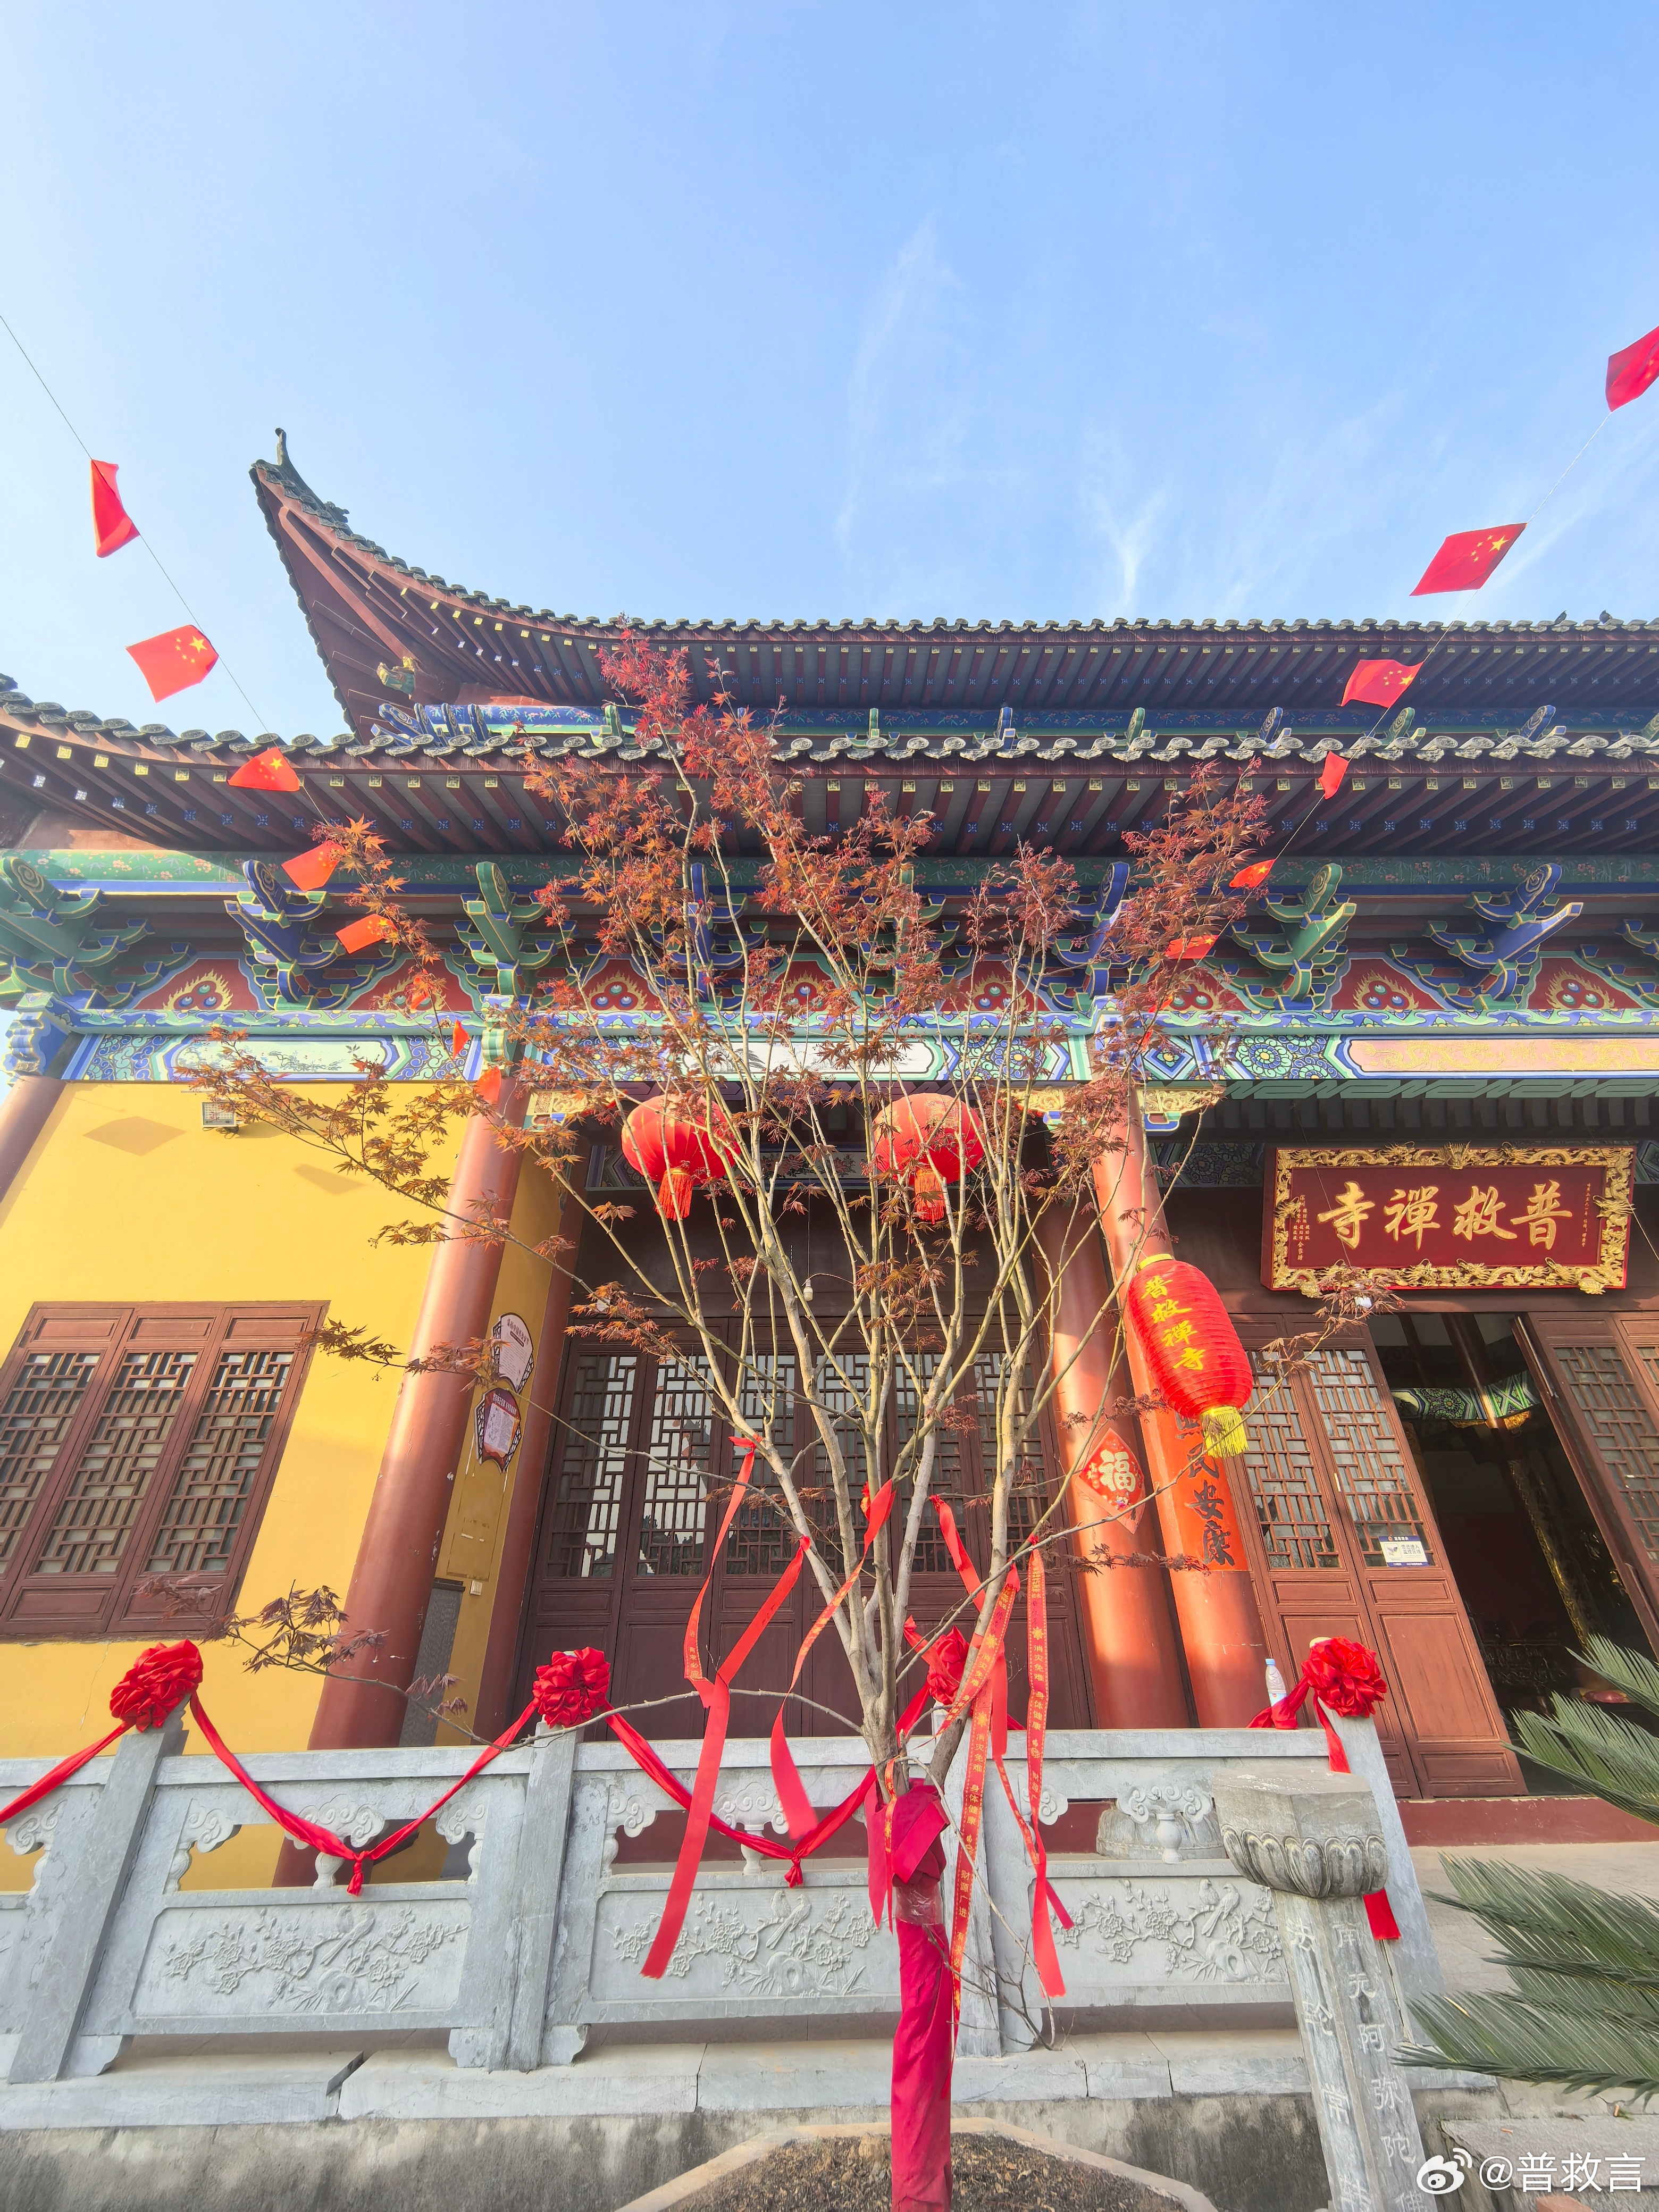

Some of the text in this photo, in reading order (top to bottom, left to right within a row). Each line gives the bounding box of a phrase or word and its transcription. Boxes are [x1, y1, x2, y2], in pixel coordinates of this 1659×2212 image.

[1317, 1179, 1572, 1251] 普救禪寺
[1141, 1275, 1206, 1370] 普救禪寺
[1099, 1449, 1136, 1493] 福
[689, 1647, 699, 1678] 有求必应
[1034, 1645, 1044, 1682] 消灾免难
[1032, 1691, 1045, 1731] 身体健康
[973, 1733, 985, 1772] 消灾免难
[966, 1784, 980, 1825] 身体健康
[959, 1870, 971, 1918] 财源广进
